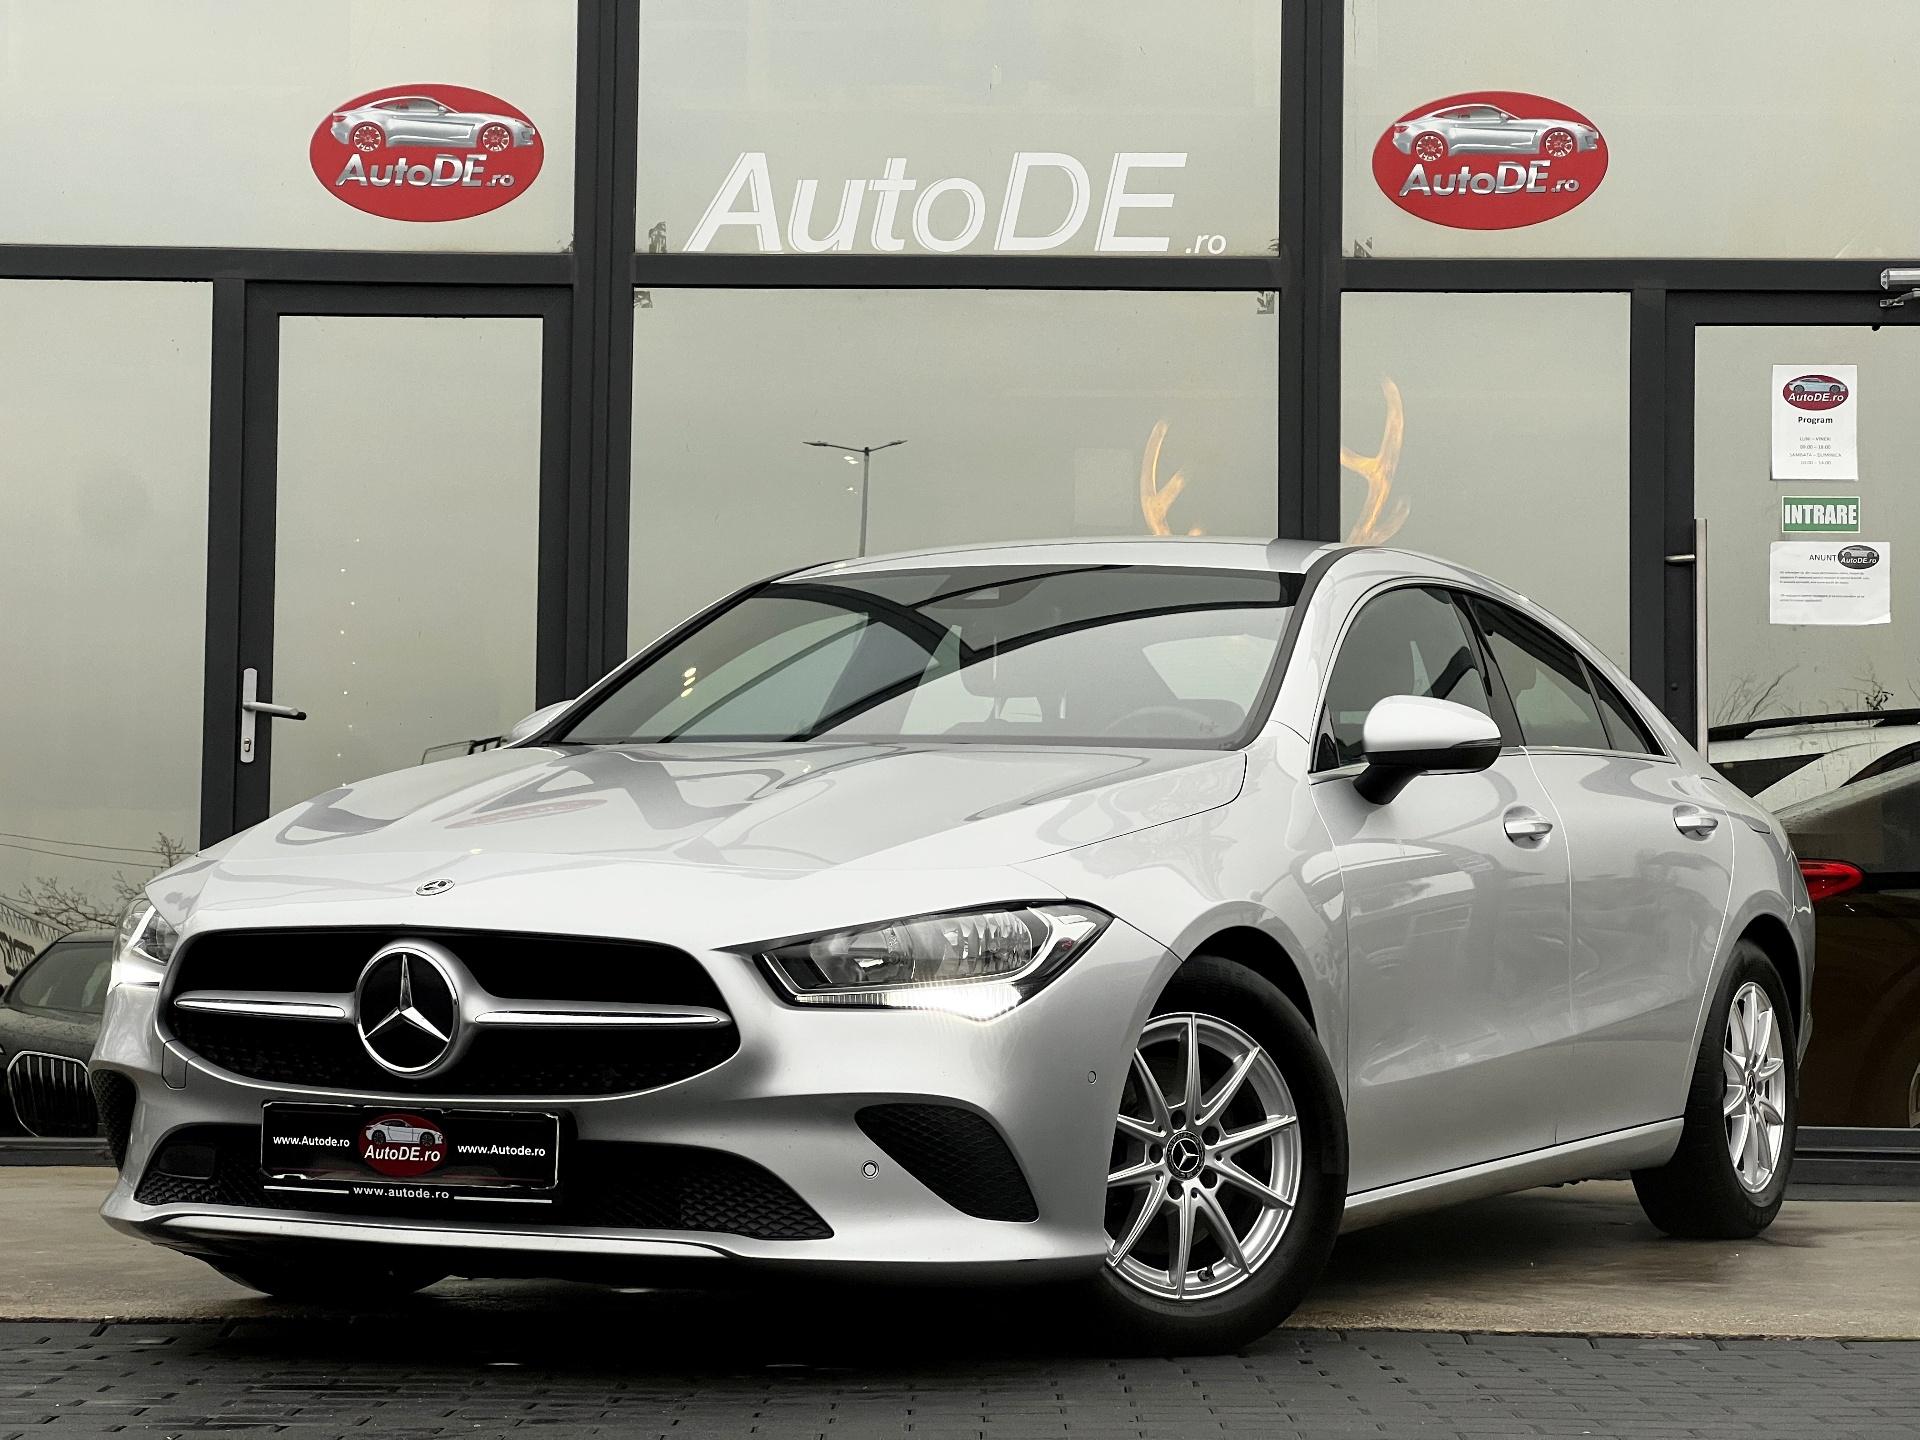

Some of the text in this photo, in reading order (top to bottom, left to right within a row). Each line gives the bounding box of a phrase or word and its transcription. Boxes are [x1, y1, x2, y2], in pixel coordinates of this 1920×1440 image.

[1787, 393, 1844, 402] AutoDE.ro
[1798, 416, 1833, 424] Program
[1784, 504, 1858, 524] INTRARE
[273, 1135, 350, 1147] www.Autode.ro
[364, 1145, 440, 1163] AutoDE.ro
[457, 1144, 546, 1157] www.Autode.ro
[353, 1185, 450, 1200] www.autode.ro
